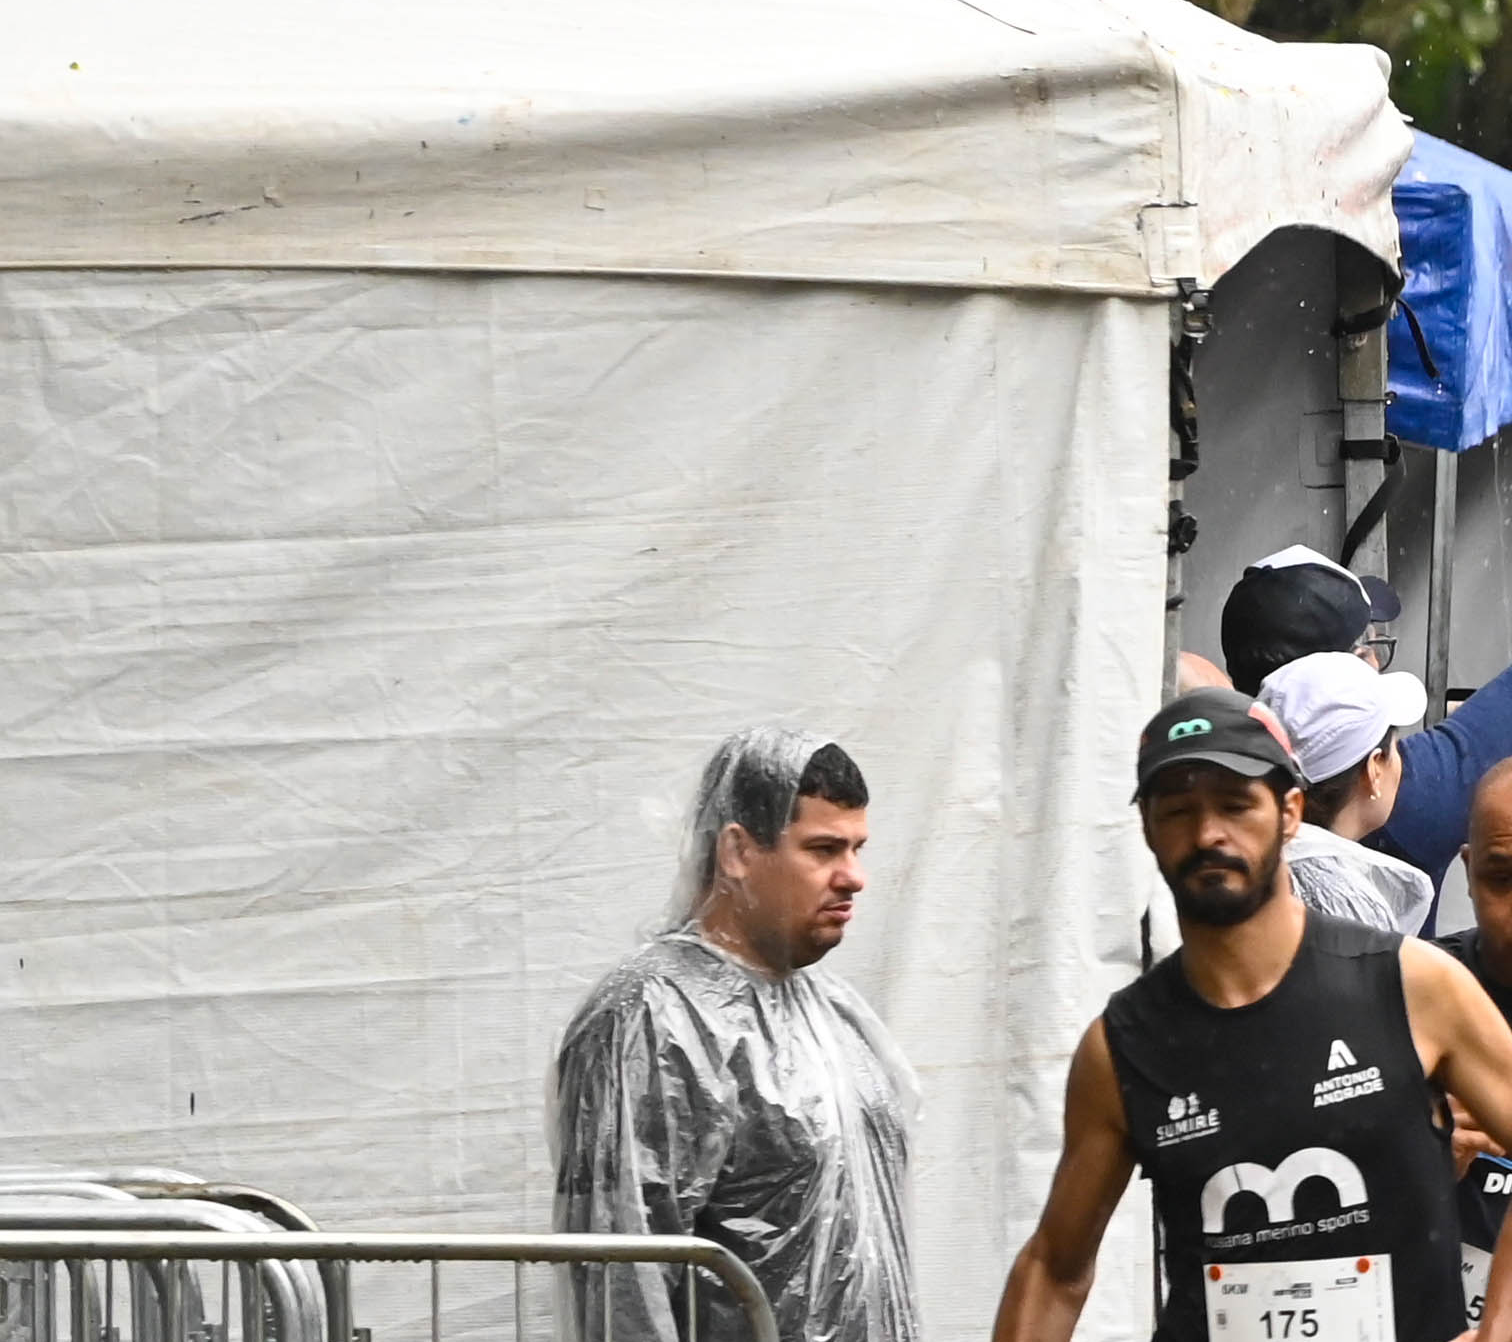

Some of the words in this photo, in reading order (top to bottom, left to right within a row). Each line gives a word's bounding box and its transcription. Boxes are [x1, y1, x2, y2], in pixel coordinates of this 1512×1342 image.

[1313, 1066, 1380, 1095] ANTONIO
[1313, 1077, 1384, 1108] ANDRADE
[1256, 1223, 1315, 1243] merino
[1317, 1209, 1371, 1233] sports
[1259, 1309, 1319, 1339] 175
